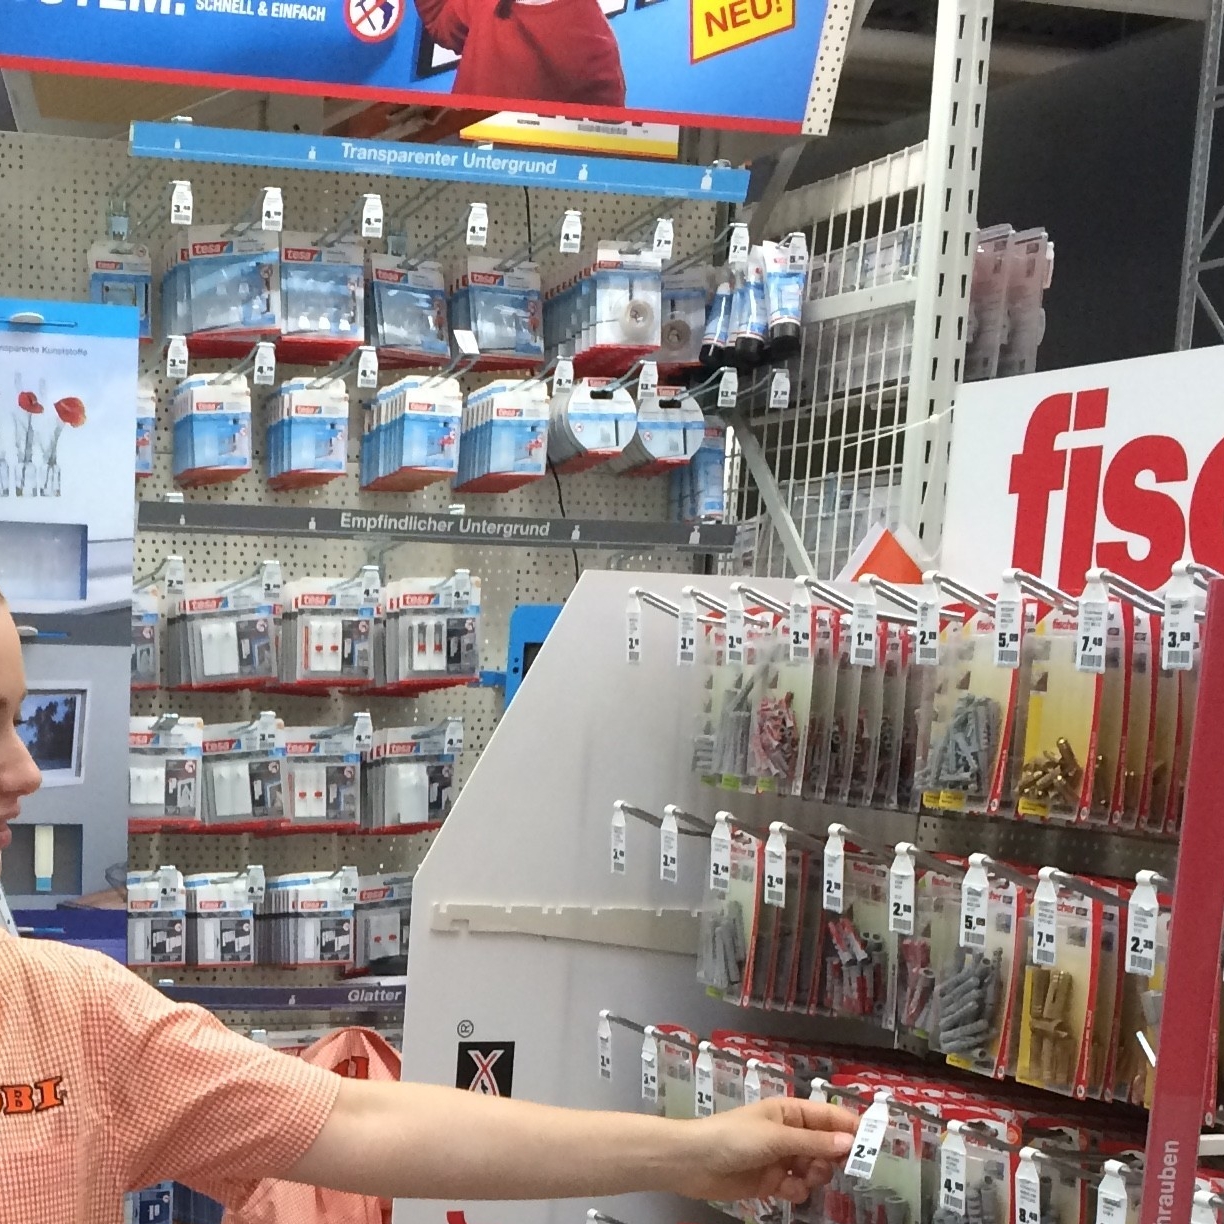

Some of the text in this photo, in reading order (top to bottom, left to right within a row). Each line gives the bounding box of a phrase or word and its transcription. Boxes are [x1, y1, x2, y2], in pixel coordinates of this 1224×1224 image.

[196, 0, 254, 16] SCHNELL
[258, 2, 268, 16] &
[271, 3, 326, 22] EINFACH
[342, 142, 557, 175] Transparenter Untergrund
[193, 243, 222, 255] tesa
[286, 249, 312, 261] tesa
[340, 513, 550, 538] Empfindlicher Untergrund
[190, 598, 217, 610] tesa
[303, 595, 327, 606] tesa
[404, 594, 431, 606] tesa
[204, 740, 230, 752] tesa
[287, 743, 310, 753] tesa
[390, 744, 414, 754] tesa
[348, 989, 402, 1002] Glatter
